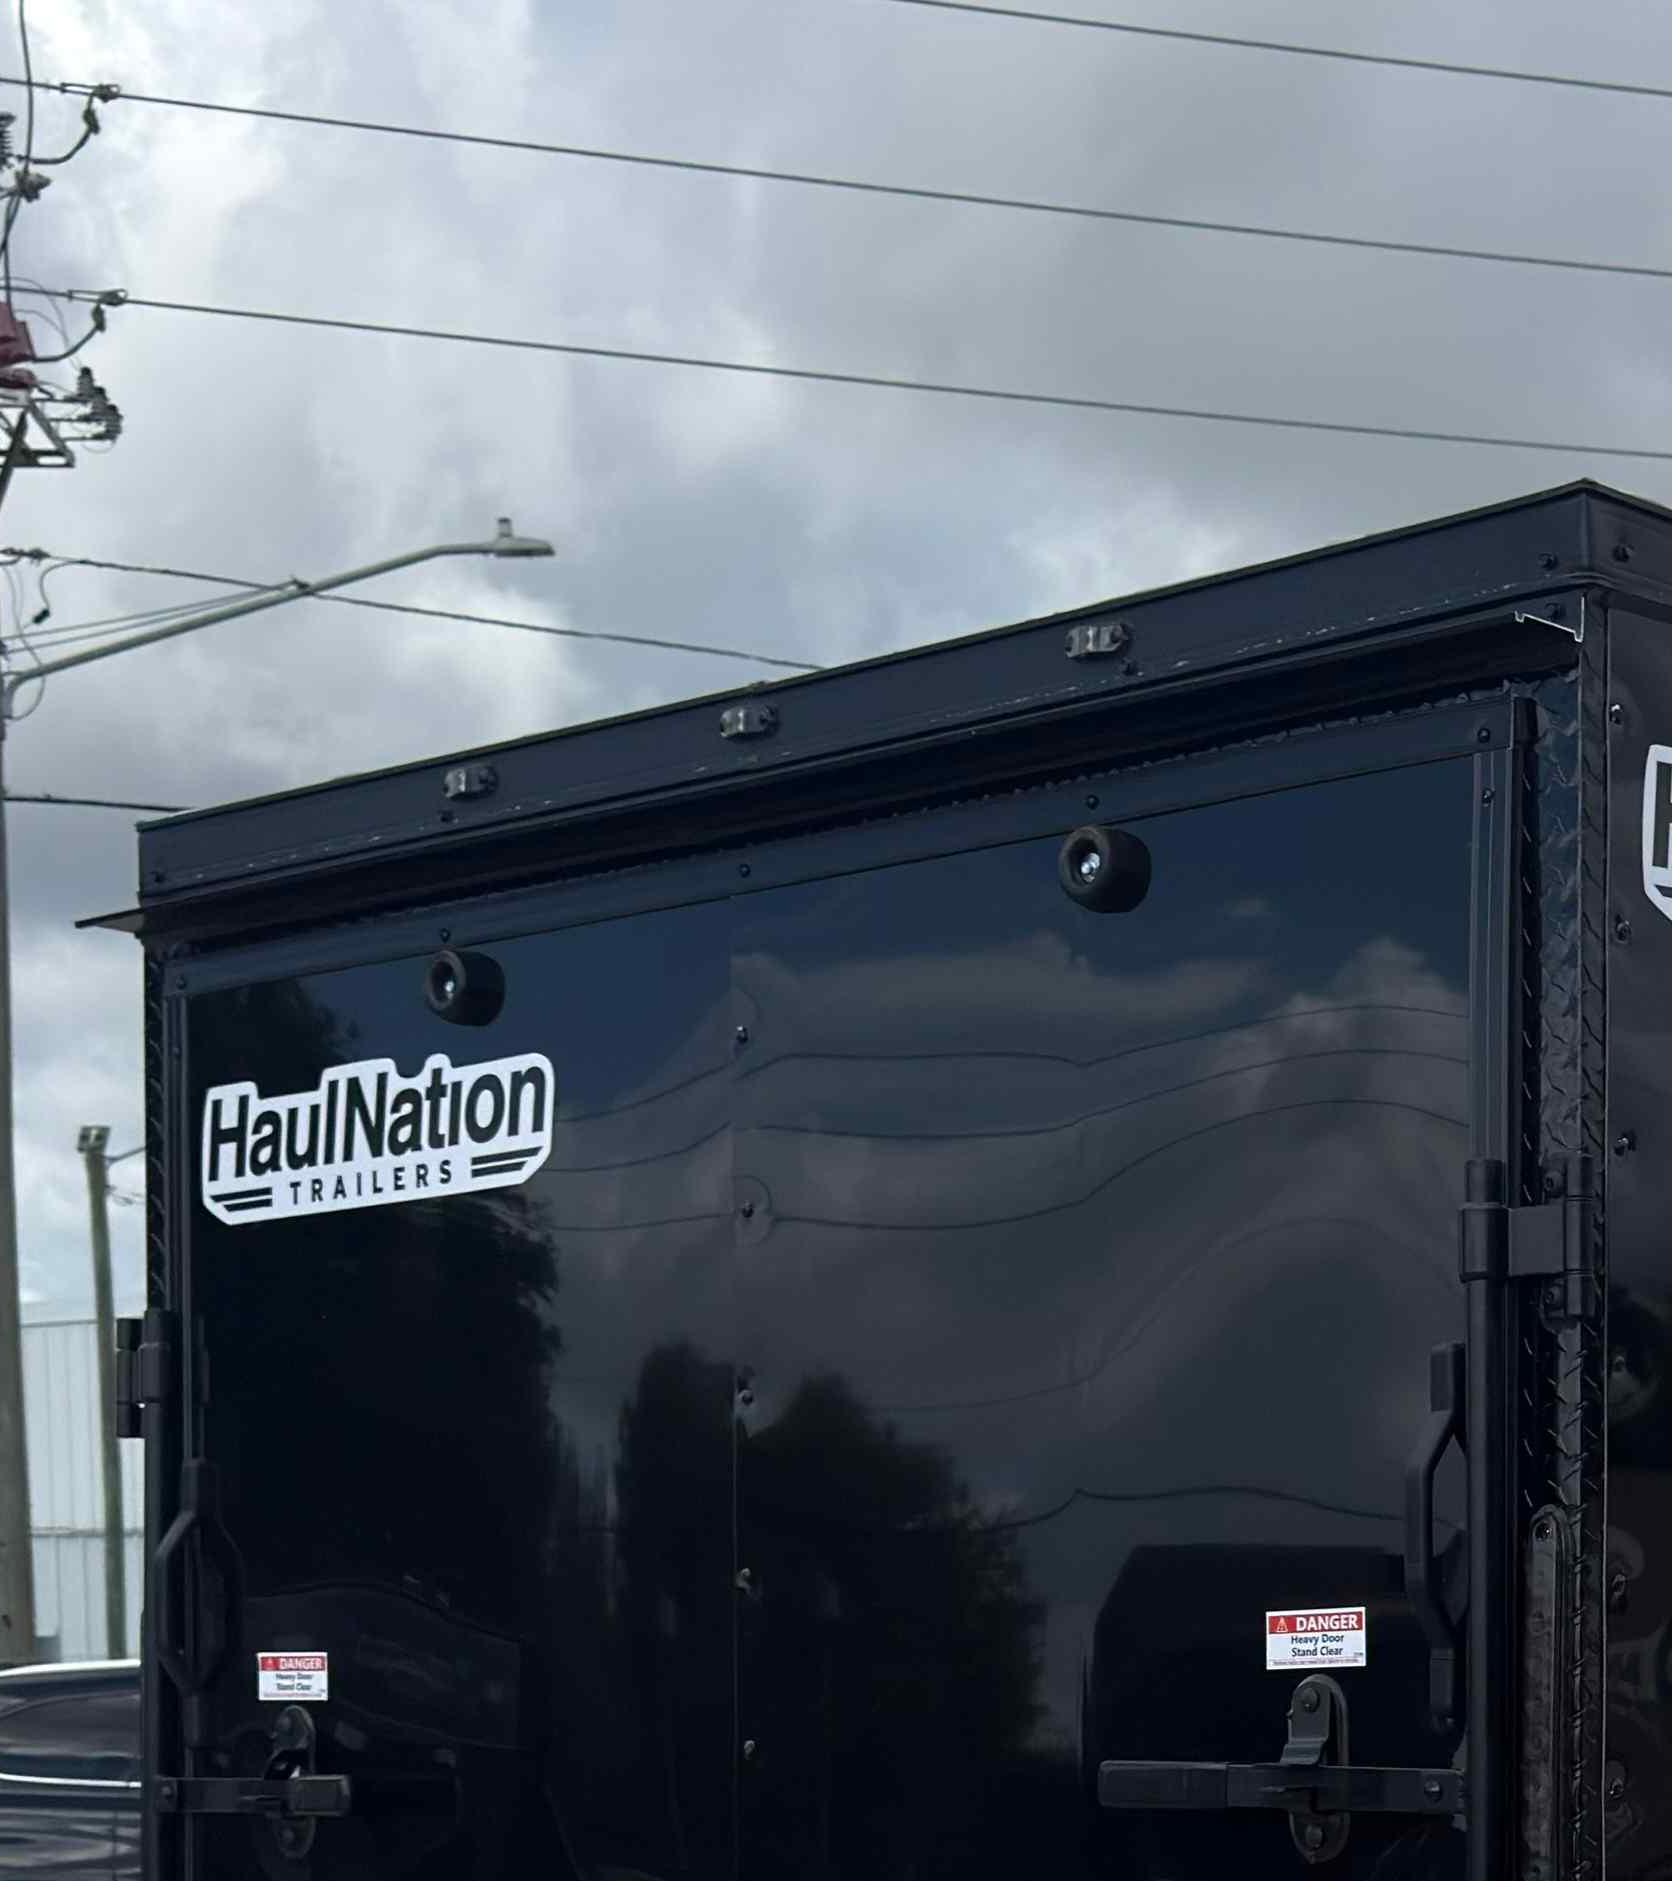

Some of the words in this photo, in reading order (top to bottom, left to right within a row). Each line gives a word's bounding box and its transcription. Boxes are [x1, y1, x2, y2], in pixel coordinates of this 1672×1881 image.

[208, 1065, 545, 1182] HaulNation
[289, 1159, 453, 1207] TRAILERS
[1295, 1614, 1358, 1631] DANGER
[1291, 1635, 1319, 1646] Heavy
[1321, 1634, 1344, 1643] Door
[1291, 1647, 1317, 1657] Stand
[1320, 1646, 1343, 1656] Clear
[279, 1657, 322, 1670] DANGER
